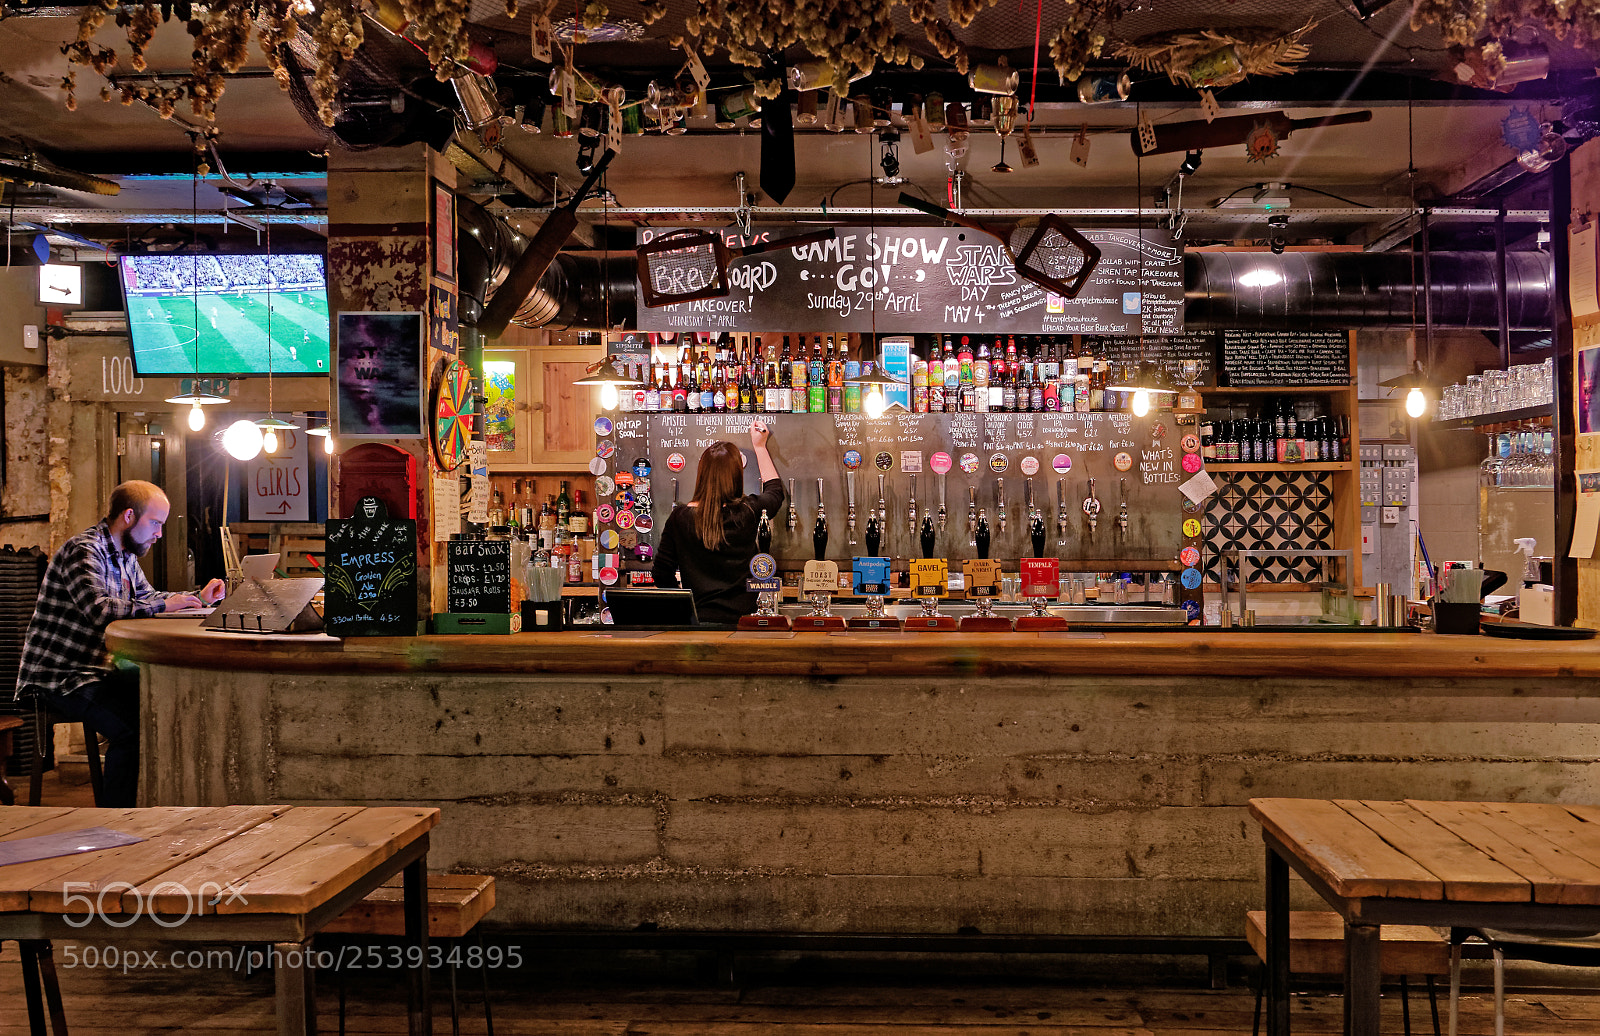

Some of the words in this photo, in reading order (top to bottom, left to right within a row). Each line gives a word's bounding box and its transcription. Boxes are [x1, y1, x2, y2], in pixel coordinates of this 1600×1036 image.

[1108, 233, 1146, 250] TAKEOVERS
[791, 234, 857, 262] GAME
[865, 233, 949, 265] SHOW
[946, 245, 1015, 267] STAR
[1066, 255, 1084, 265] APRI
[837, 264, 891, 293] GO!
[946, 266, 1016, 286] WARS
[1098, 268, 1121, 276] SIREN
[1123, 268, 1138, 277] TAP
[1141, 269, 1180, 278] TAKEOVER
[1151, 279, 1183, 287] TAKEOVER
[962, 285, 990, 301] DAY
[1001, 287, 1021, 301] FANCY
[688, 295, 754, 314] TAKEOVER!
[807, 292, 851, 317] Sunday
[854, 291, 885, 311] 29th
[885, 292, 921, 313] April
[997, 297, 1021, 311] THEMED
[1021, 288, 1042, 301] BEERS
[944, 304, 970, 323] MAY
[717, 315, 738, 327] APRIL
[1080, 323, 1094, 333] BEST
[101, 355, 144, 395] LOOS
[885, 384, 907, 392] 2015
[661, 415, 687, 427] AMSTEL
[696, 415, 723, 426] HEINEKEN
[1017, 413, 1034, 421] HOUSE
[1016, 421, 1034, 429] CIDER
[1053, 420, 1063, 428] IPA
[1084, 420, 1094, 429] IPA
[705, 426, 717, 436] 5%
[1139, 461, 1159, 472] NEW
[1163, 460, 1173, 471] IN
[255, 466, 300, 497] GIRLS
[1143, 472, 1181, 485] BOTTLES:
[455, 546, 475, 555] Bar
[477, 544, 506, 557] Snax
[341, 551, 396, 569] EMPRESS
[858, 560, 885, 569] Antipodes
[482, 562, 505, 574] £2.50
[917, 564, 940, 572] GAVEL
[355, 571, 382, 582] Golden
[361, 582, 376, 591] Ale
[451, 586, 481, 596] SAUSAGE
[454, 598, 478, 608] £3.50
